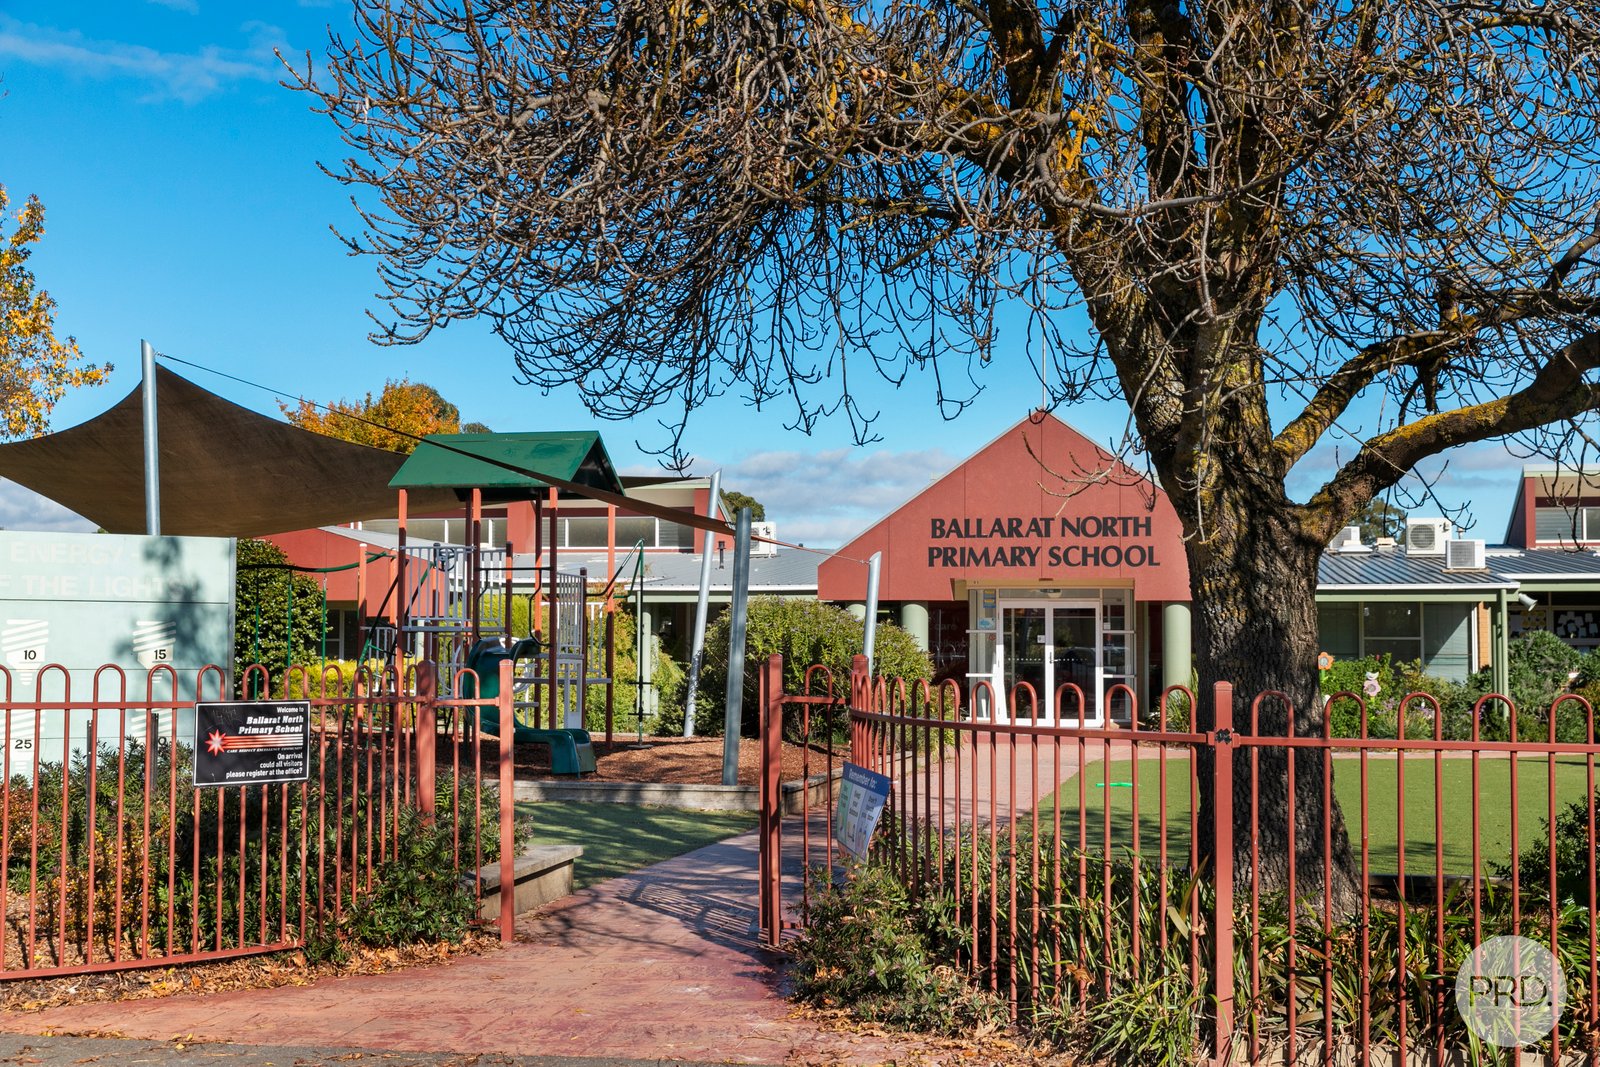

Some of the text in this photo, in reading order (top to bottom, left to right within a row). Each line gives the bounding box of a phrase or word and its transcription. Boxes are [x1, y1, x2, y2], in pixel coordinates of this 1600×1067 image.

[930, 516, 1152, 539] BALLARAT NORTH
[10, 541, 124, 565] ENERGY
[928, 544, 1161, 567] PRIMARY SCHOOL
[21, 575, 80, 596] THE
[23, 649, 37, 660] 10
[154, 649, 167, 660] 15
[246, 715, 304, 725] Ballarat North
[238, 725, 303, 735] Primary School
[14, 739, 32, 750] 25
[286, 752, 303, 760] arrival
[260, 759, 303, 769] could all visitors
[226, 770, 246, 780] please
[246, 769, 269, 779] register
[285, 767, 303, 775] office?
